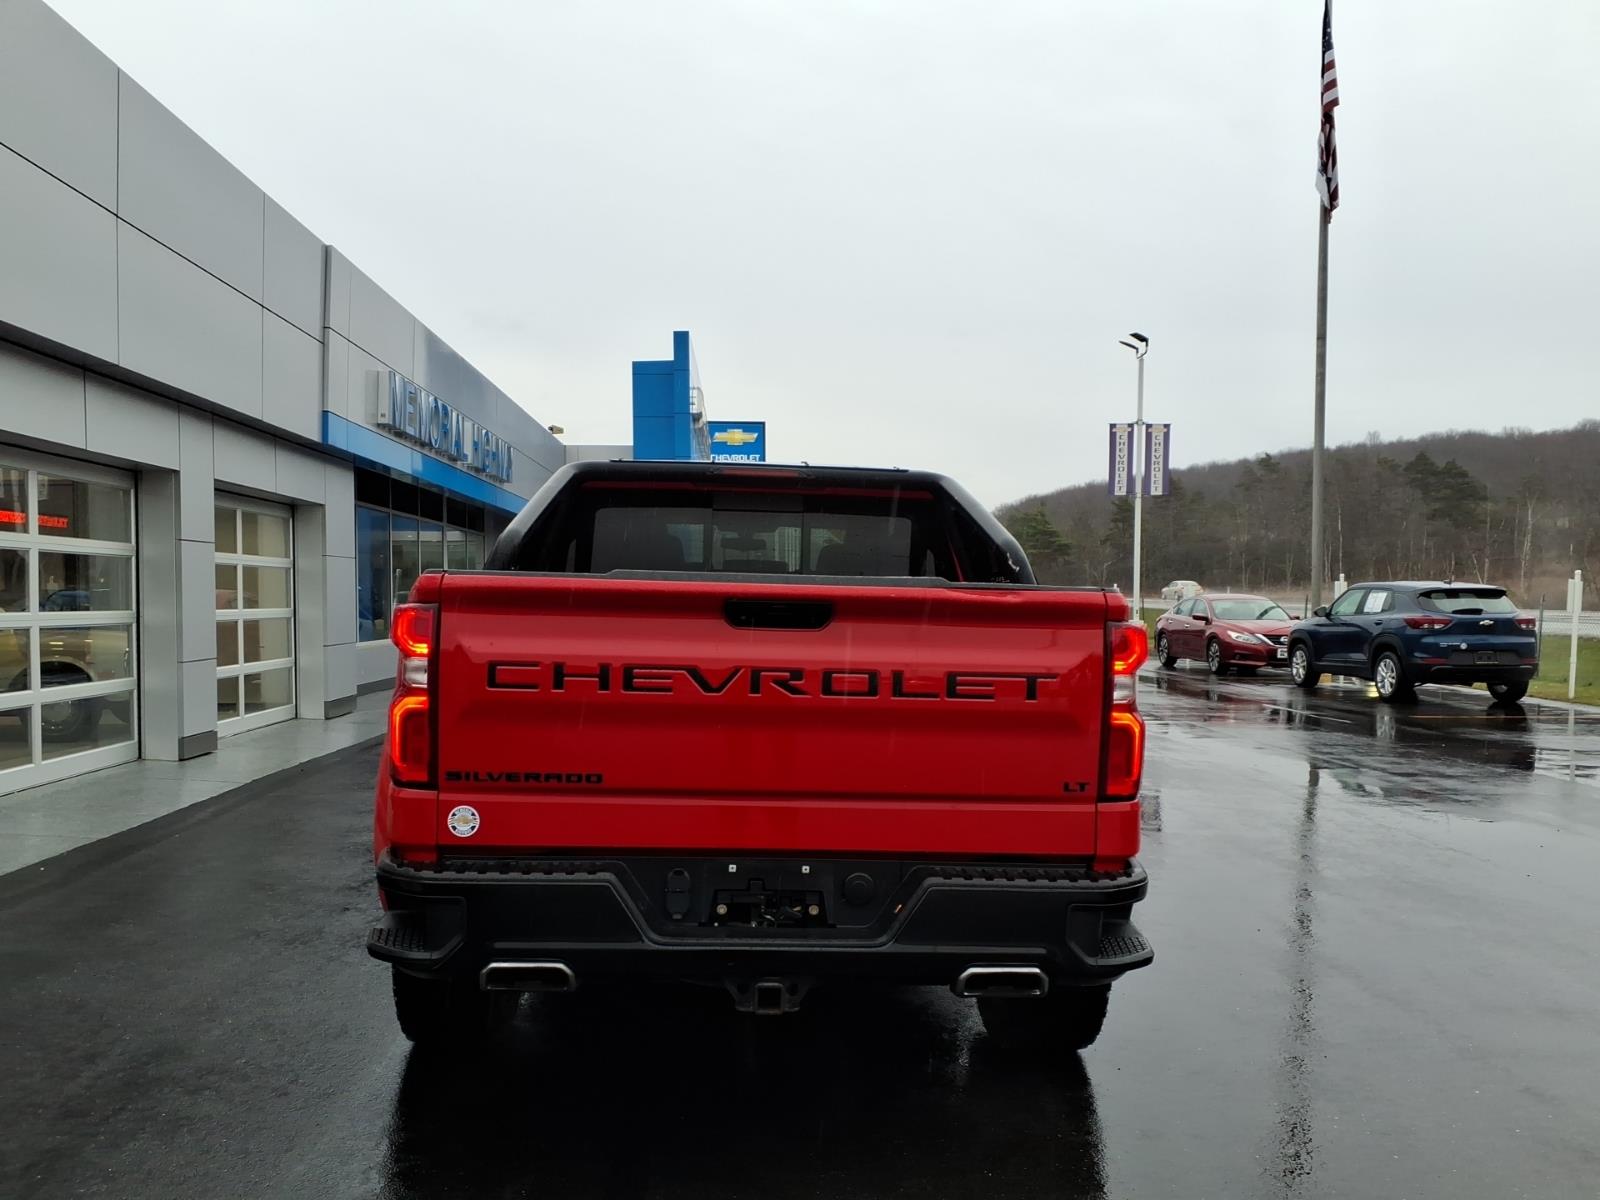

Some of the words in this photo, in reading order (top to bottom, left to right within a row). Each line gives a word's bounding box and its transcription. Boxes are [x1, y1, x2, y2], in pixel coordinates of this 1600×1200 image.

[711, 454, 760, 462] CHEVROLET
[1117, 434, 1126, 492] CHEVROLET
[1153, 434, 1162, 492] CHEVROLET
[486, 660, 1058, 702] CHEVROLET
[445, 771, 604, 784] SILVERADO
[1063, 781, 1090, 792] LT
